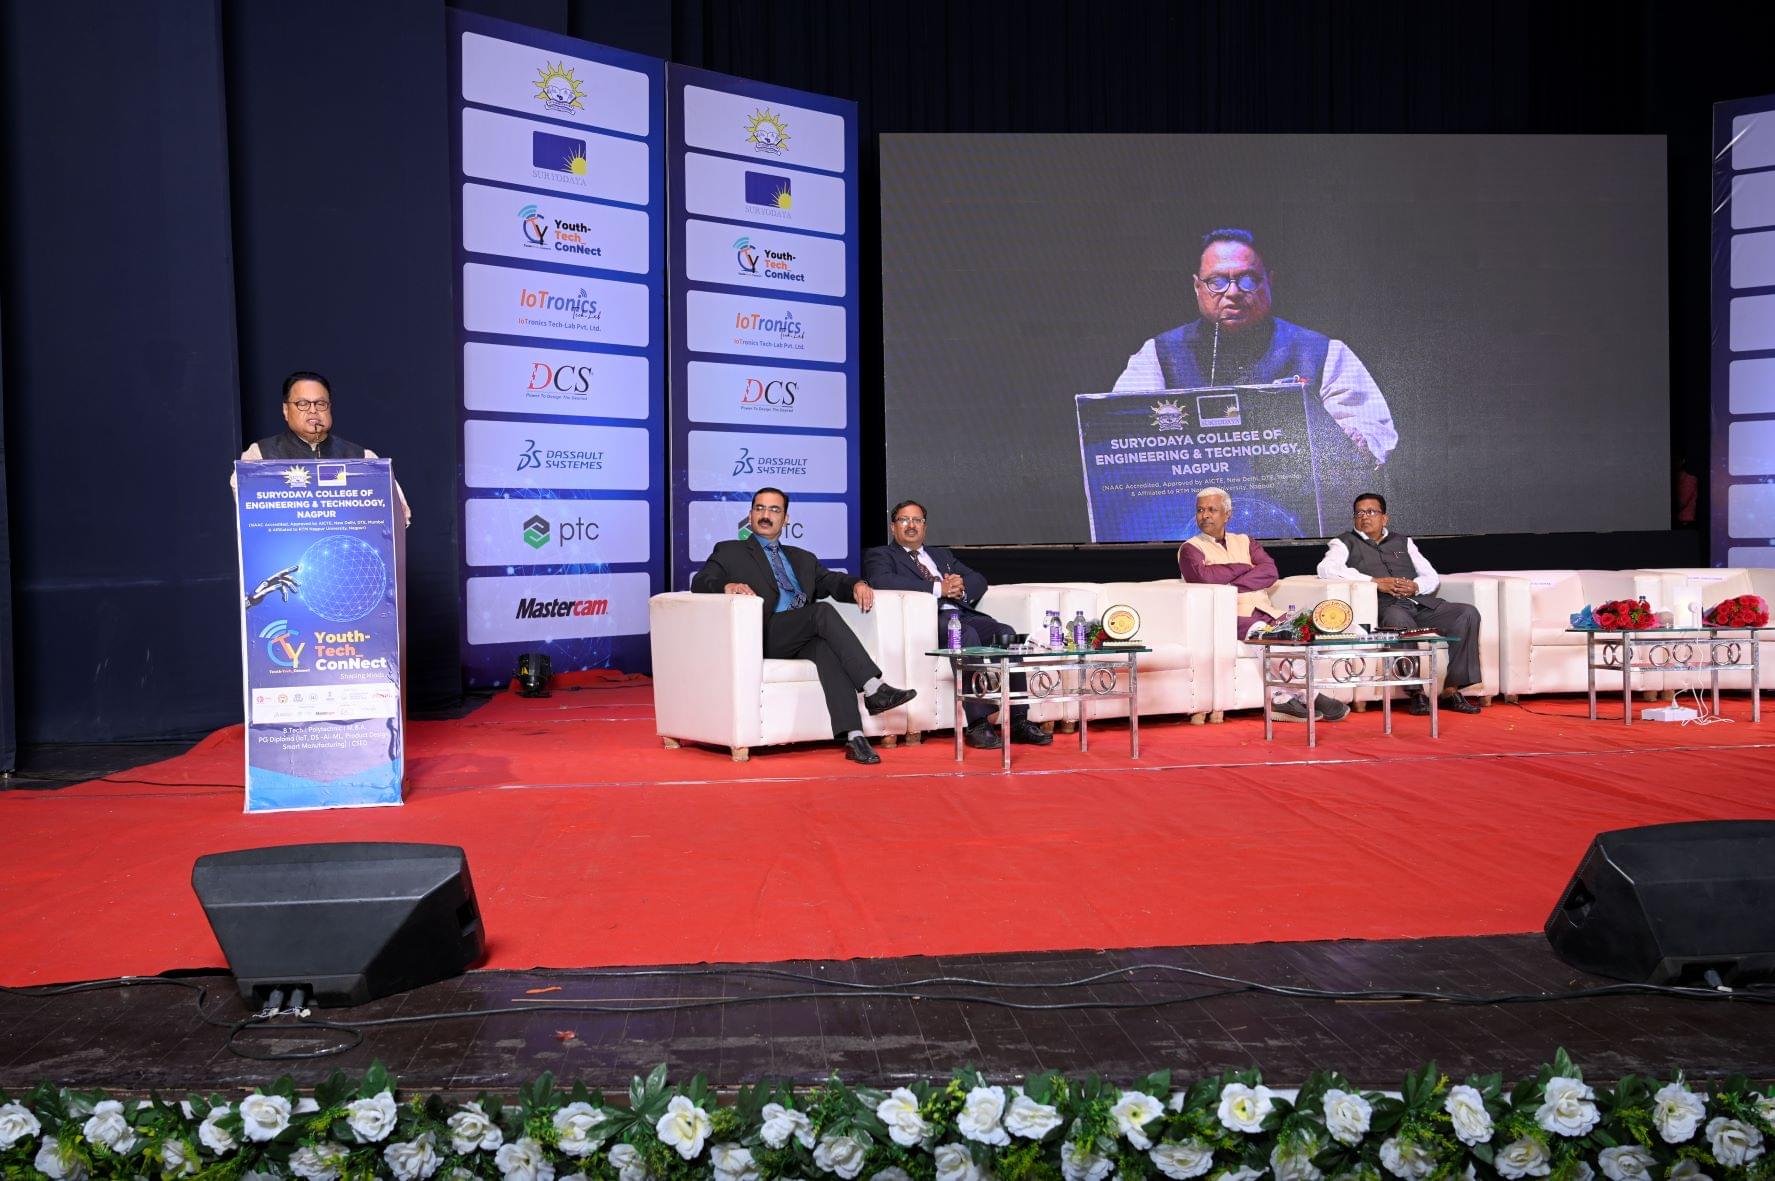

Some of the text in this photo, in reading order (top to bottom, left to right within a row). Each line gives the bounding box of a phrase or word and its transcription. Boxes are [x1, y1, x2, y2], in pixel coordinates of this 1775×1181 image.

[532, 170, 587, 186] SURYODAYA
[745, 206, 792, 219] SURYODAYA
[554, 219, 592, 233] Youth-
[554, 242, 602, 256] ConNect
[764, 250, 796, 261] Youth-
[764, 270, 805, 282] ConNect
[520, 288, 598, 314] IoTronics
[736, 312, 802, 334] IoTronics
[528, 363, 592, 394] DCS
[741, 378, 799, 406] DCS
[1110, 430, 1282, 450] SURYODAYA COLLEGE OF
[546, 450, 604, 460] DASSAULT
[758, 458, 808, 466] DASSAULT
[1096, 450, 1190, 466] ENGINEERING
[1193, 448, 1202, 459] &
[1172, 462, 1229, 476] NAGPUR
[1162, 480, 1192, 488] Approved
[1194, 478, 1203, 486] by
[256, 490, 313, 499] SURYODAYA
[316, 490, 358, 498] COLLEGE
[245, 500, 310, 509] ENGINEERING
[321, 499, 386, 508] TECHNOLOGY,
[297, 510, 336, 519] NAGPUR
[560, 517, 600, 547] ptc
[516, 598, 608, 619] Mastercam
[314, 630, 370, 644] Youth-
[315, 657, 387, 671] ConNect
